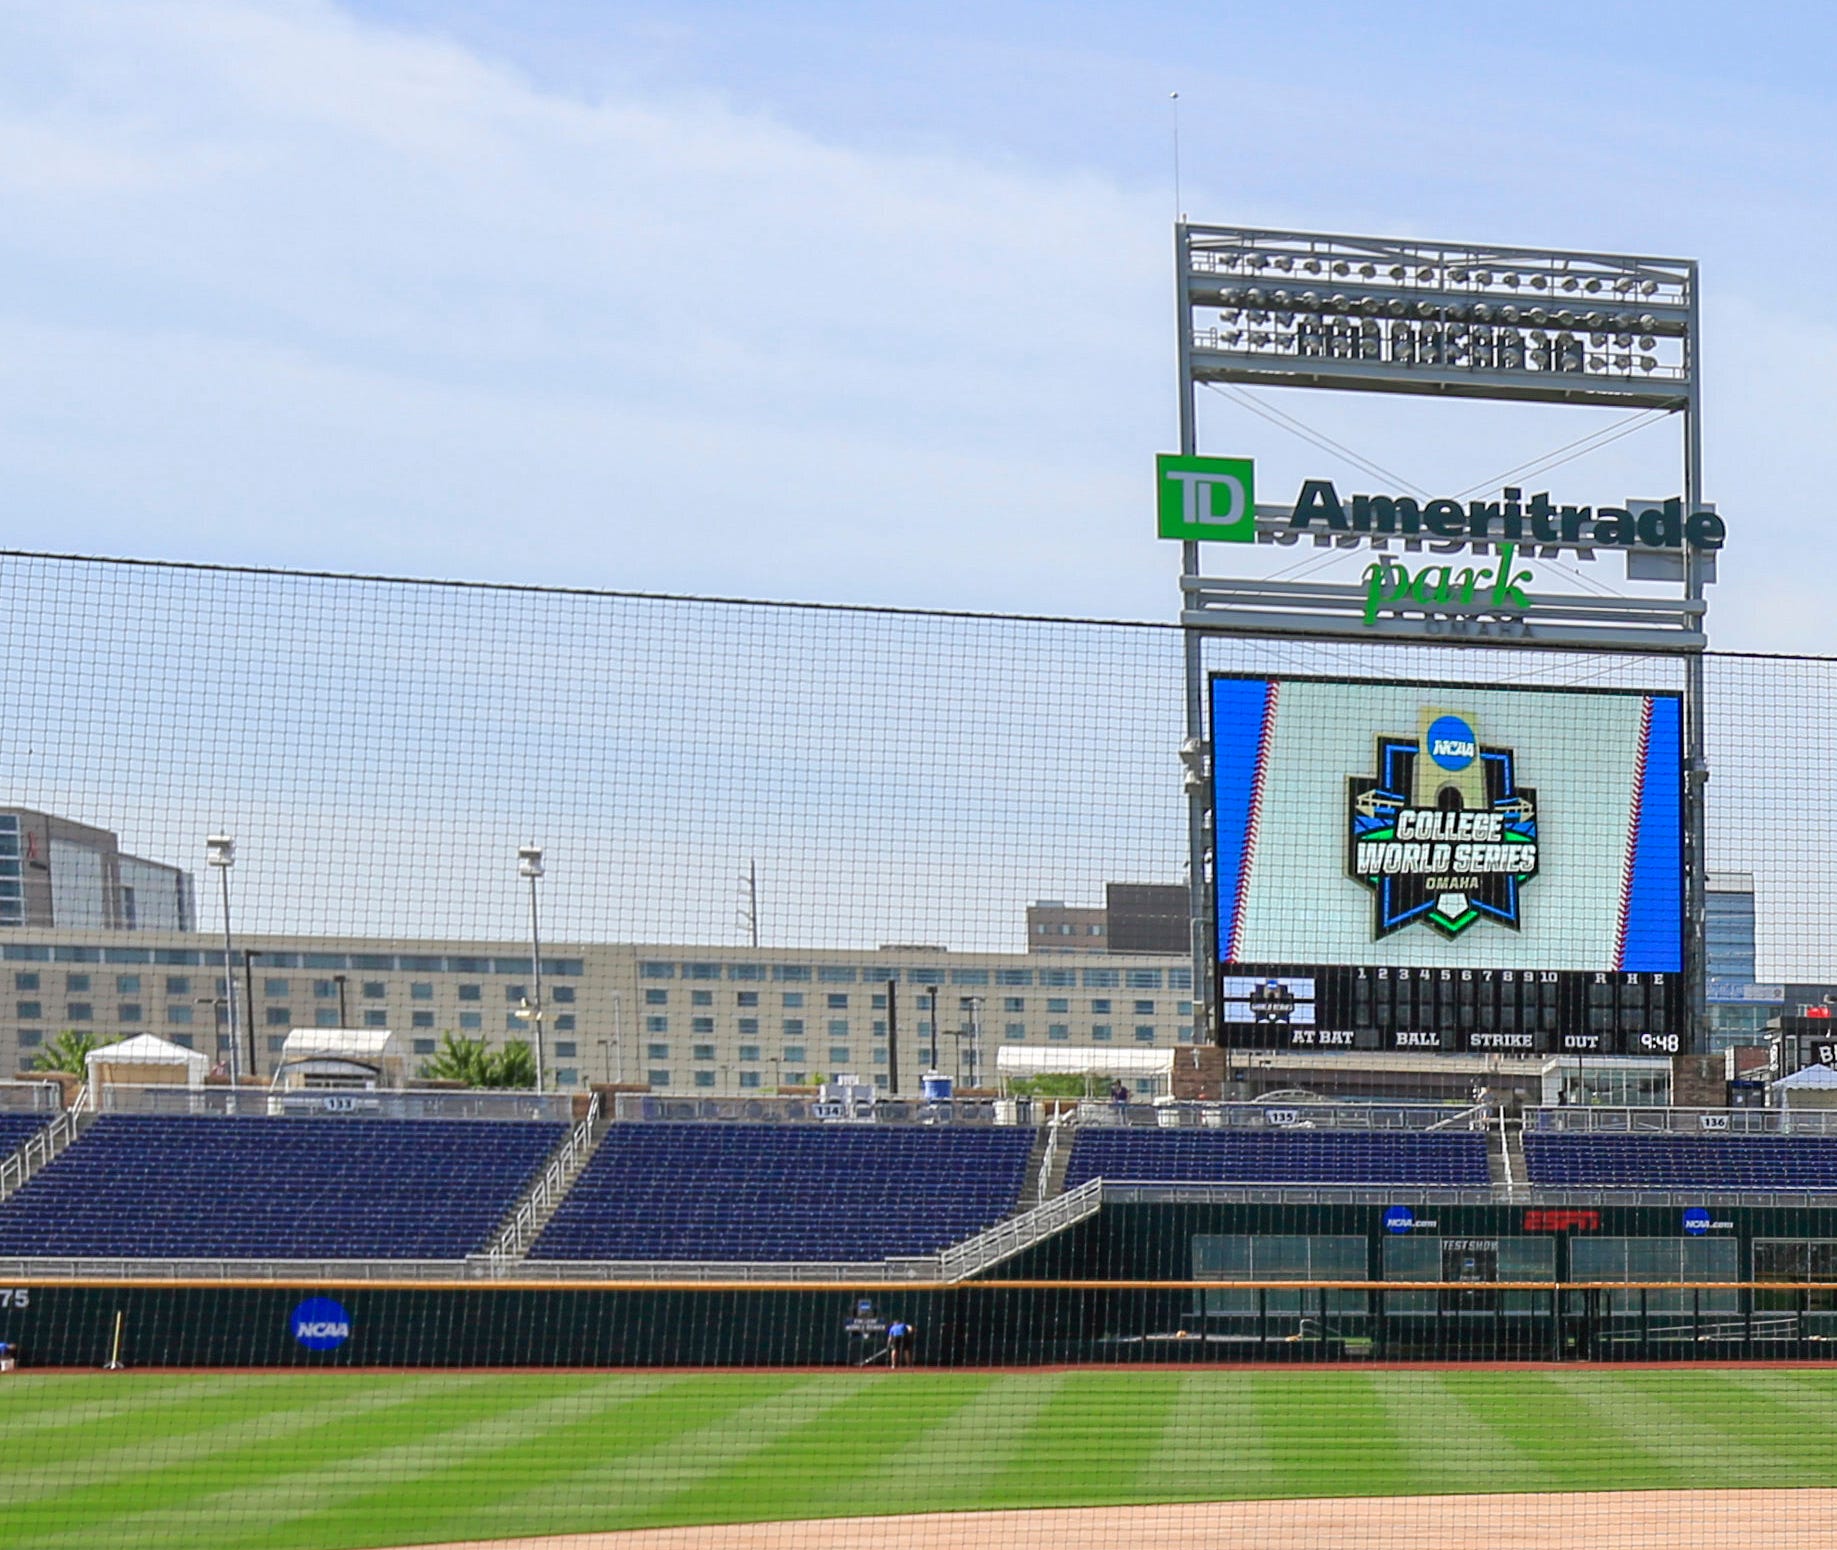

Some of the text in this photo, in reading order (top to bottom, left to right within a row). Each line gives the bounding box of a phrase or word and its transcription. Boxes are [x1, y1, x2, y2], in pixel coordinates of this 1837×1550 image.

[1167, 471, 1245, 526] TD
[1289, 480, 1726, 550] Ameritrade
[1361, 543, 1533, 626] park
[1432, 739, 1475, 758] NCAA
[1396, 809, 1504, 842] COLLEGE
[1357, 842, 1537, 875] WORLD SERIES
[1425, 876, 1479, 890] OMAHA
[1357, 967, 1664, 985] 1 2 3 4 5 6 7 8 9 10 R H E
[1292, 1030, 1598, 1048] AT BAT BALL STRIKE OUT
[1641, 1033, 1679, 1052] 9:48
[1273, 1112, 1292, 1122] 135
[1704, 1117, 1725, 1127] 136
[1386, 1218, 1437, 1228] NCAA.com
[1523, 1210, 1599, 1231] ESPN
[1685, 1219, 1734, 1229] NCAA.com
[296, 1321, 349, 1338] NCAA
